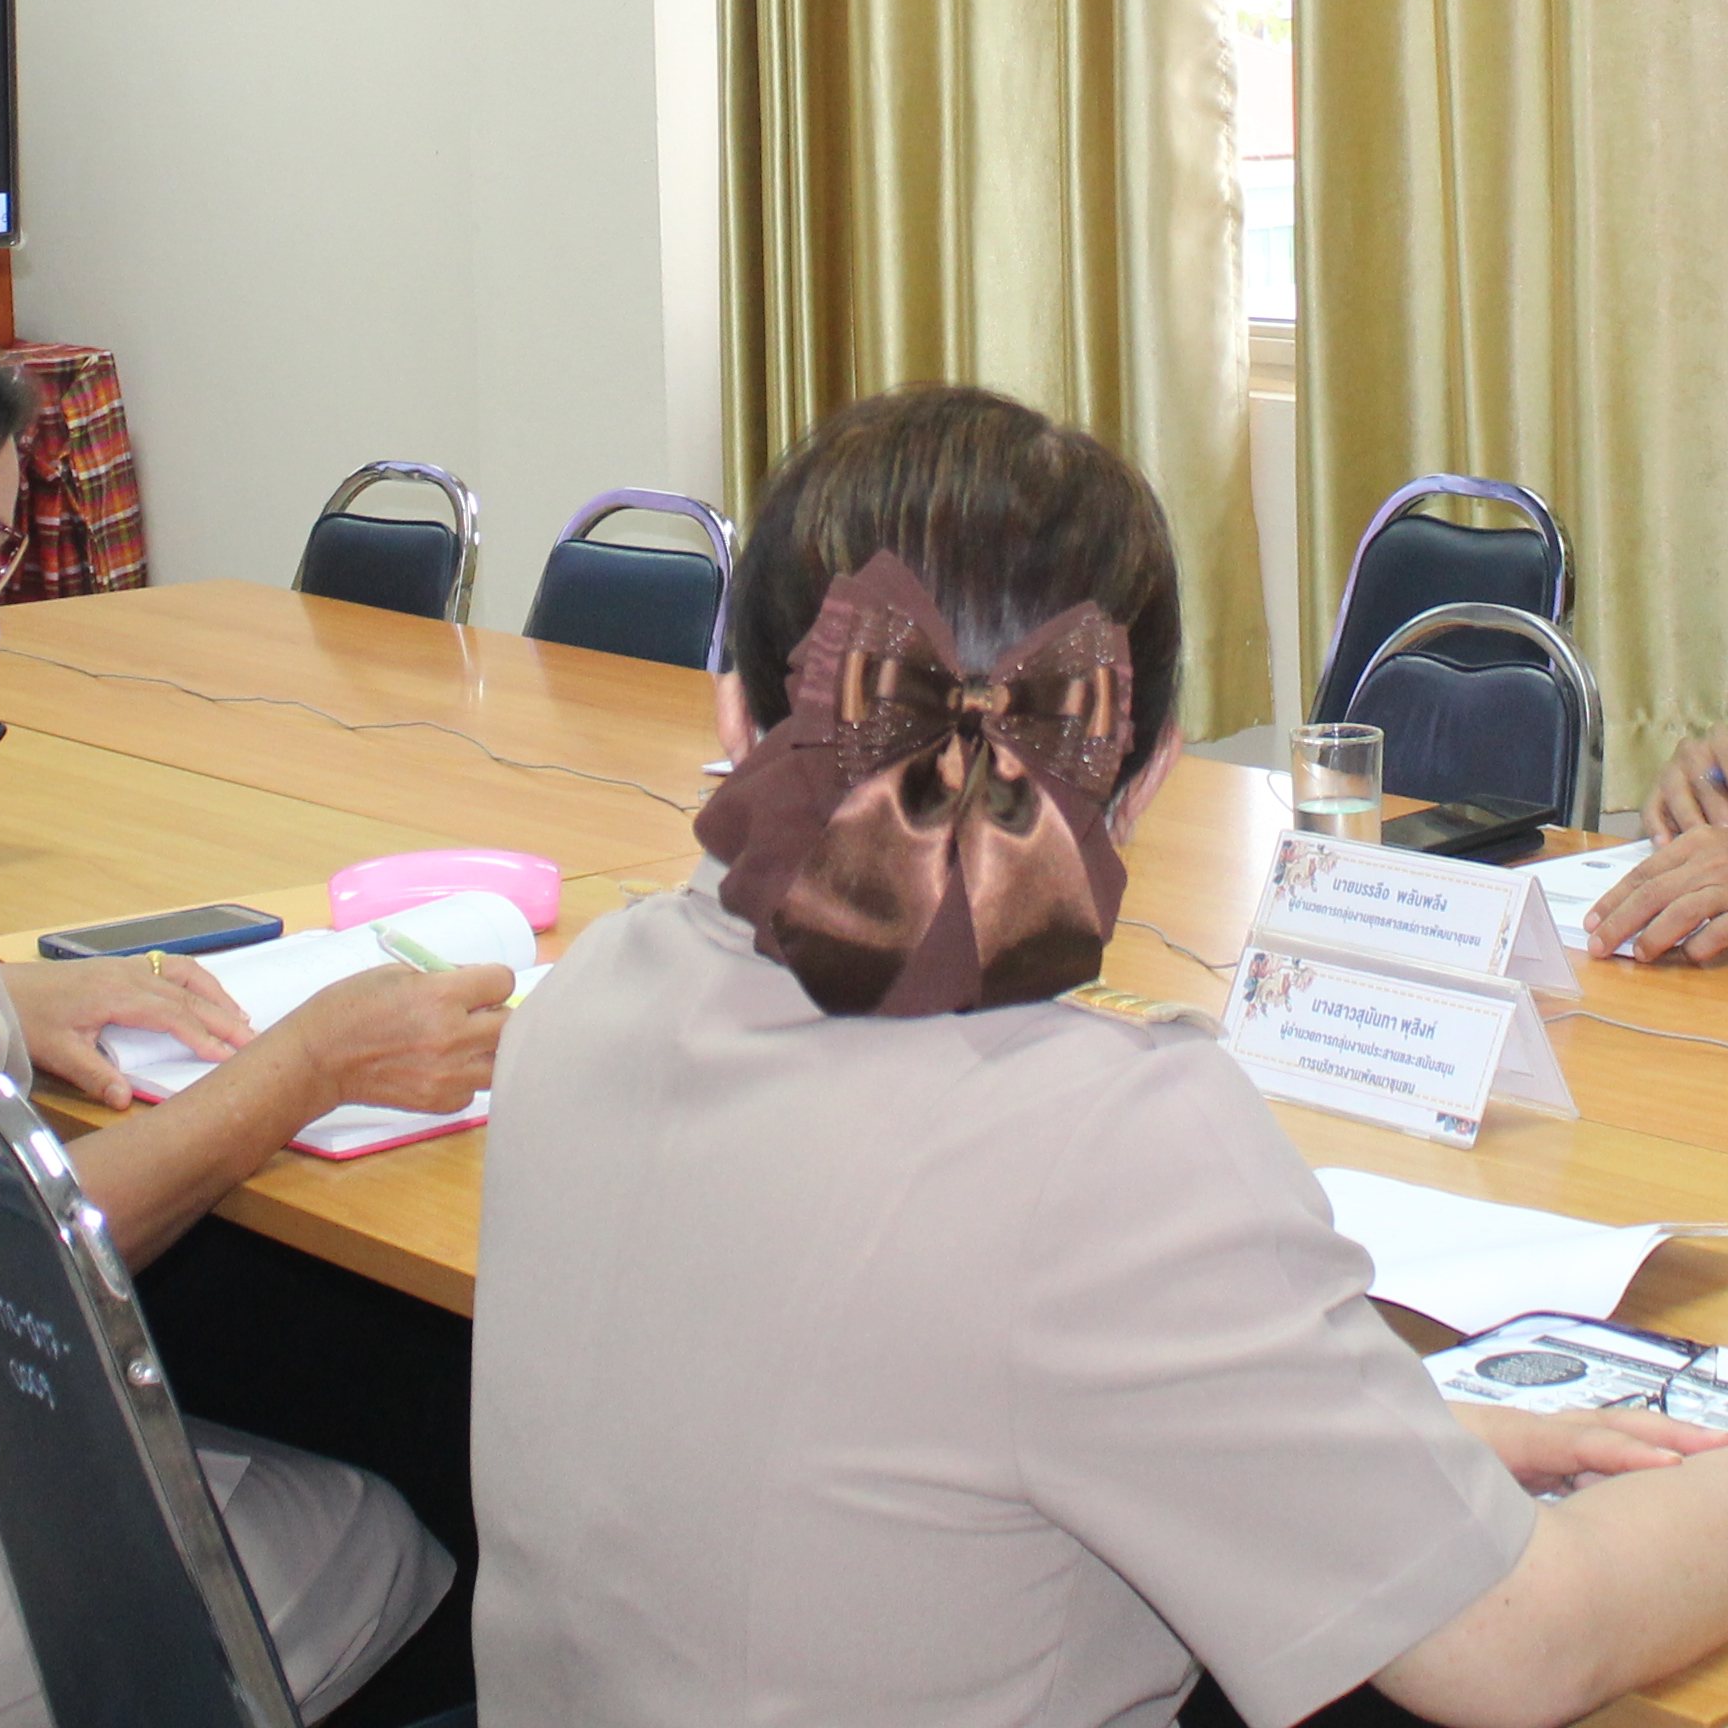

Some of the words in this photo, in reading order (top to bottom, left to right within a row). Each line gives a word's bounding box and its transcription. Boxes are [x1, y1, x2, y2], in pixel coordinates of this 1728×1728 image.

[1332, 876, 1390, 900] นายบรรลือ
[1396, 888, 1448, 913] พลับพลึง
[1311, 997, 1398, 1032] นางสาวสุนันทา
